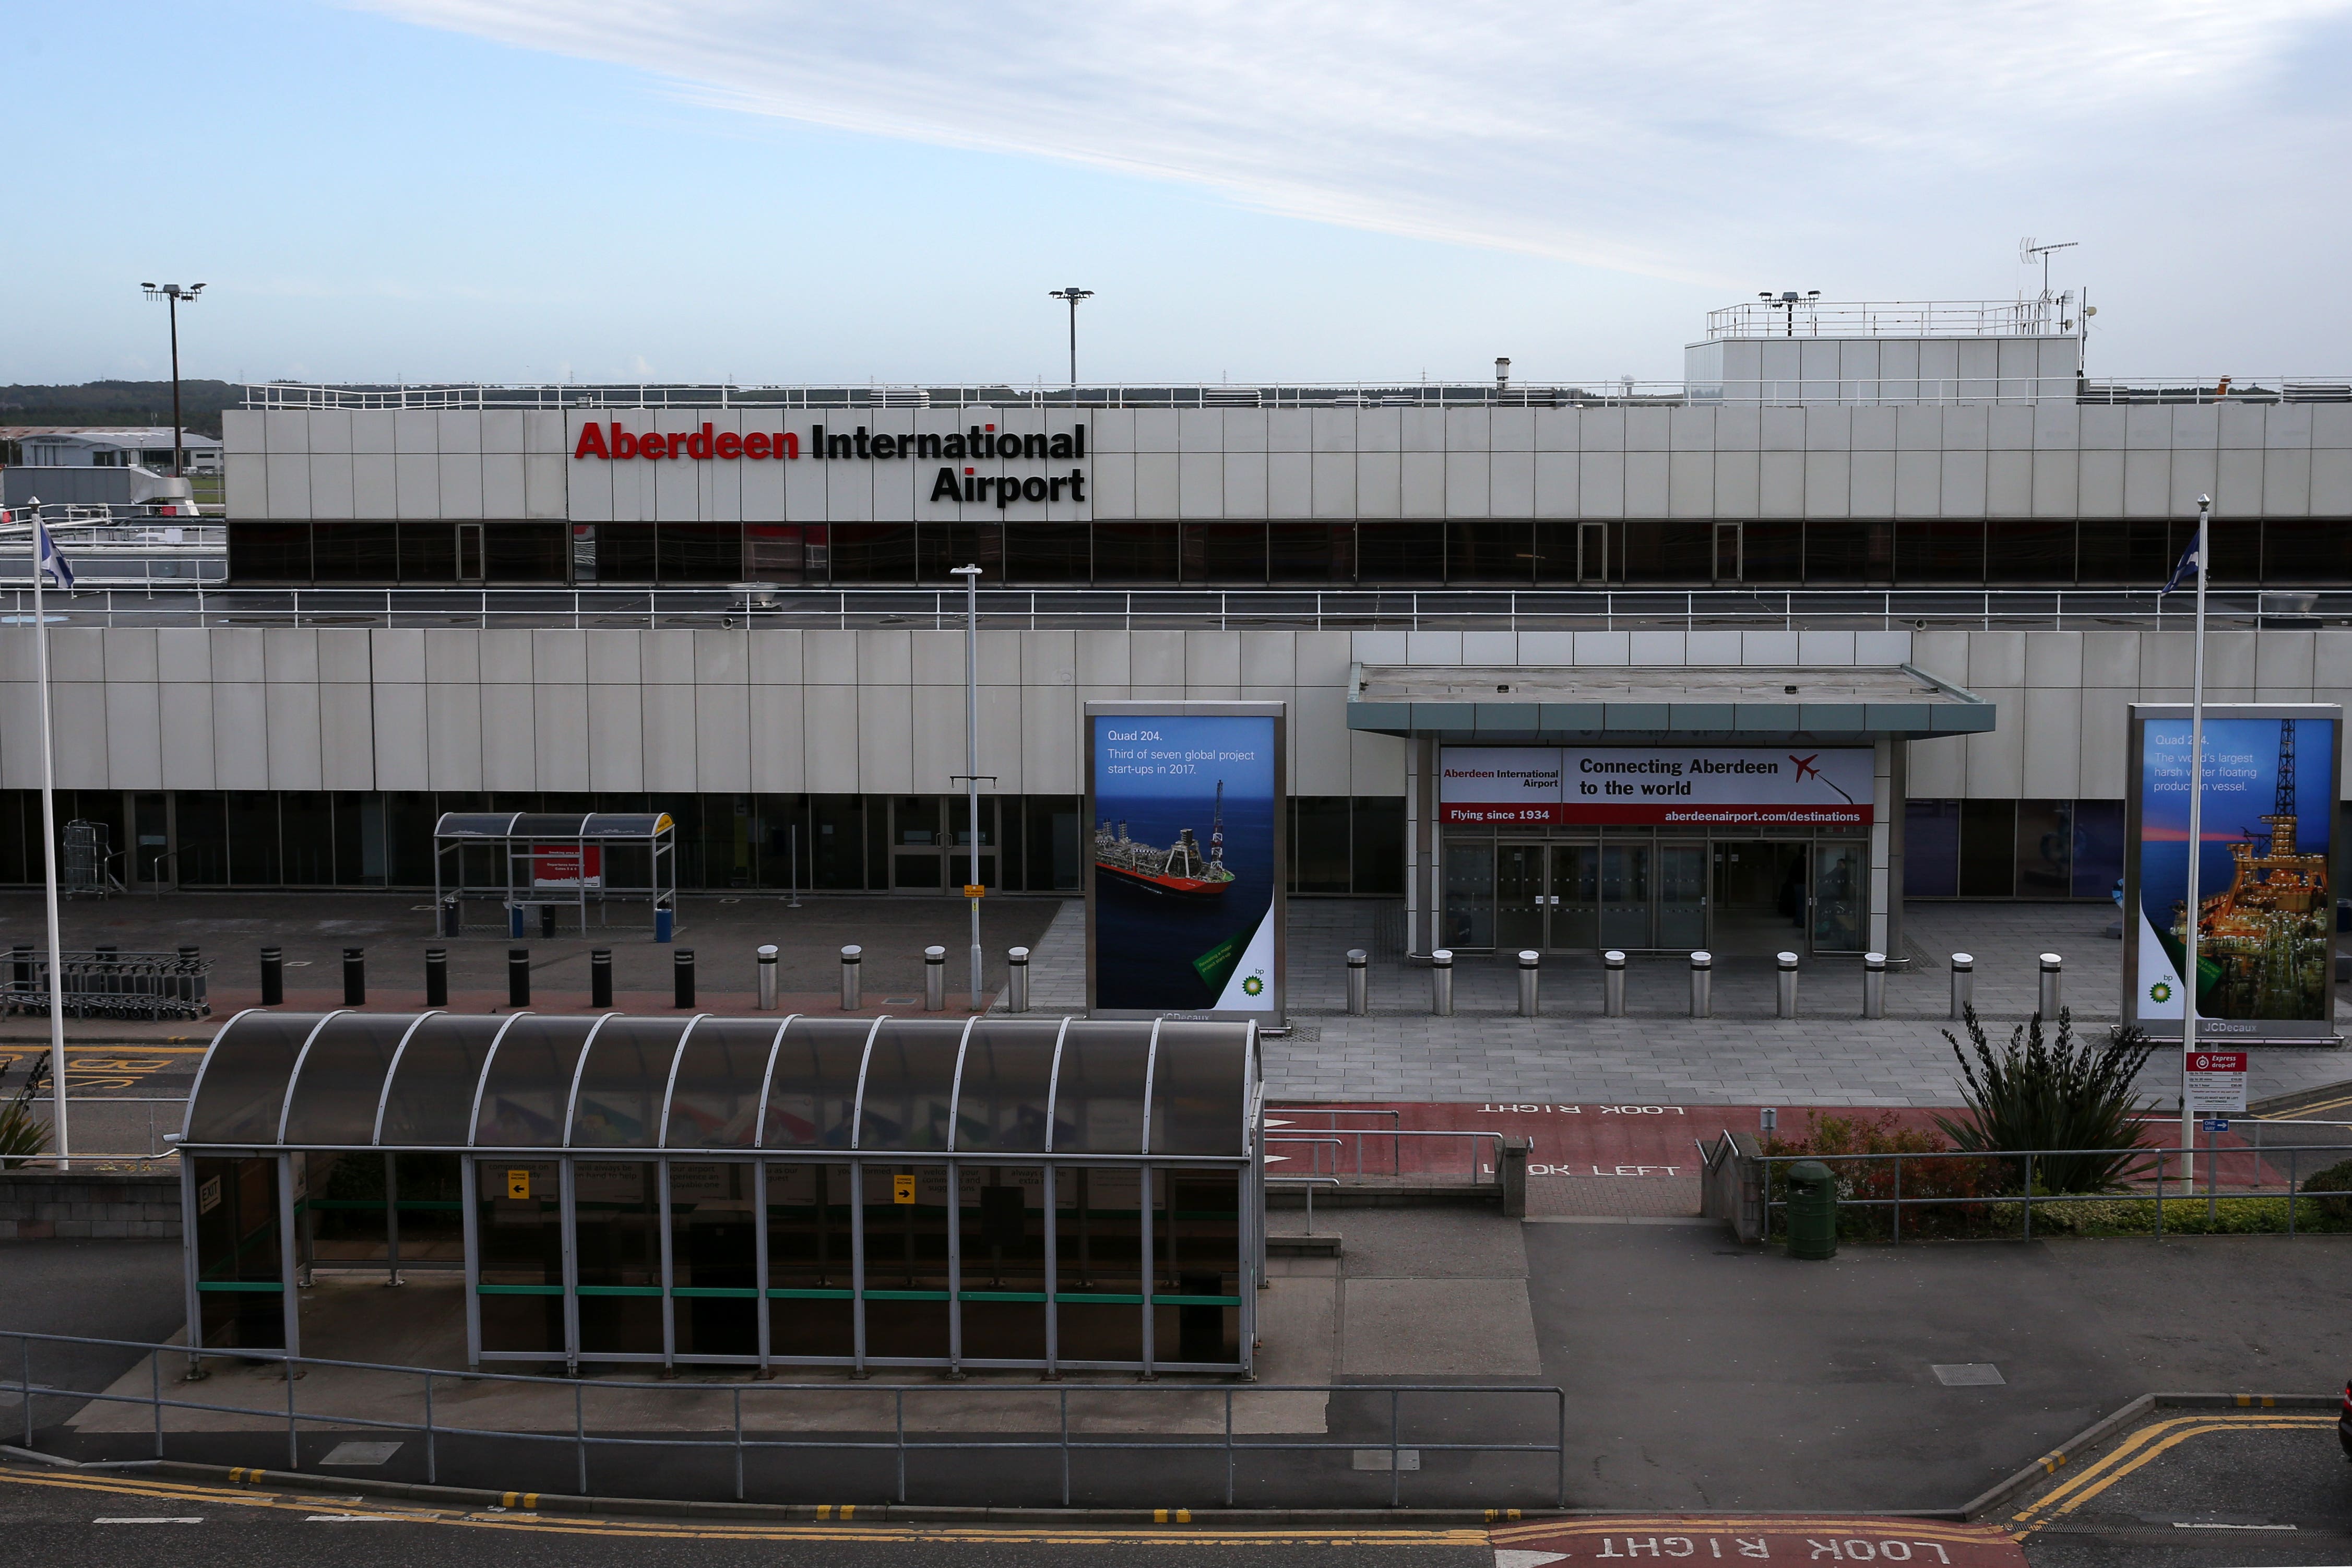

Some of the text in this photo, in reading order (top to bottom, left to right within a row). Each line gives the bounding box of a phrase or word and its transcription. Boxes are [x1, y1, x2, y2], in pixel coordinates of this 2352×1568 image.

[574, 422, 1085, 460] Aberdeen International
[930, 467, 1085, 508] Airport
[1108, 730, 1162, 741] Quad 204.
[2156, 735, 2209, 745] Quad 24.
[1108, 748, 1255, 762] Third of seven global project
[2155, 753, 2174, 762] The
[2218, 753, 2253, 764] largest
[1108, 764, 1196, 776] start-ups in 2017.
[1579, 758, 1778, 776] Connecting Aberdeen
[1443, 769, 1559, 778] Aberdeen International
[2154, 768, 2182, 777] harsh
[2219, 768, 2257, 779] floating
[1523, 779, 1559, 789] Airport
[1579, 781, 1691, 795] to the world
[2212, 782, 2247, 791] vessel.
[1451, 810, 1550, 821] Flying since 1934
[1665, 811, 1860, 823] aberdeenairport.com/destinations
[2163, 974, 2173, 982] bp
[2204, 1023, 2257, 1032] JCDecaux
[1477, 1103, 1684, 1115] LOOK RIGHT
[1483, 1163, 1681, 1177] LOK LEFT
[202, 1180, 218, 1201] EXIT
[1596, 1537, 1951, 1565] LOOK RIGHT
